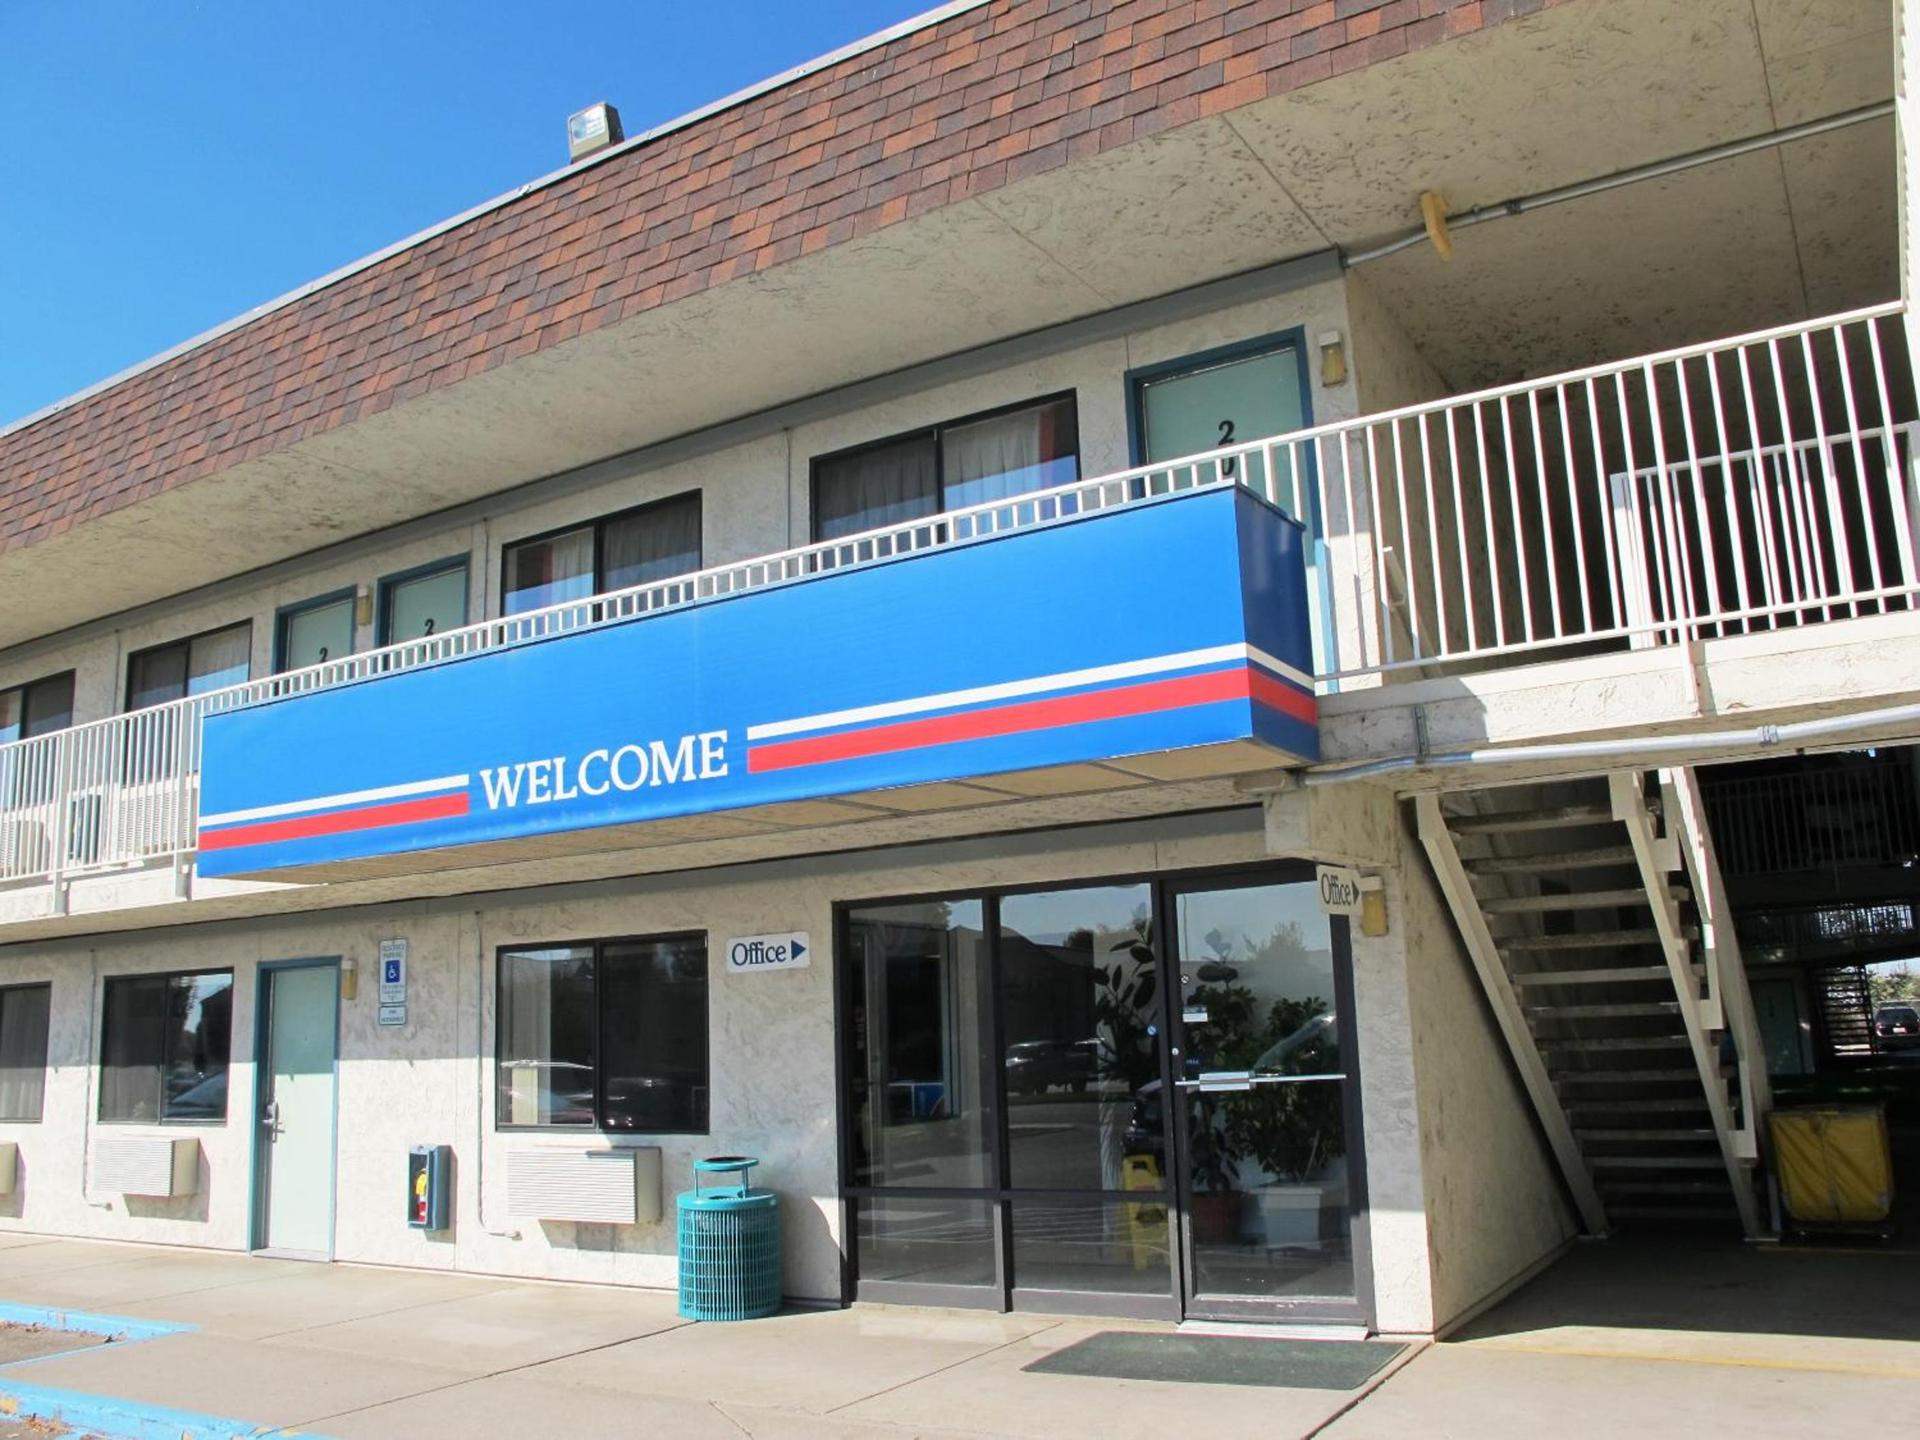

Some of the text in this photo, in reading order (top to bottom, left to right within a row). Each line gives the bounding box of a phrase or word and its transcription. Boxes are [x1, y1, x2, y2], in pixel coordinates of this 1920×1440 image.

[479, 729, 728, 811] WELCOME
[1321, 873, 1351, 905] Office
[732, 941, 787, 967] Office
